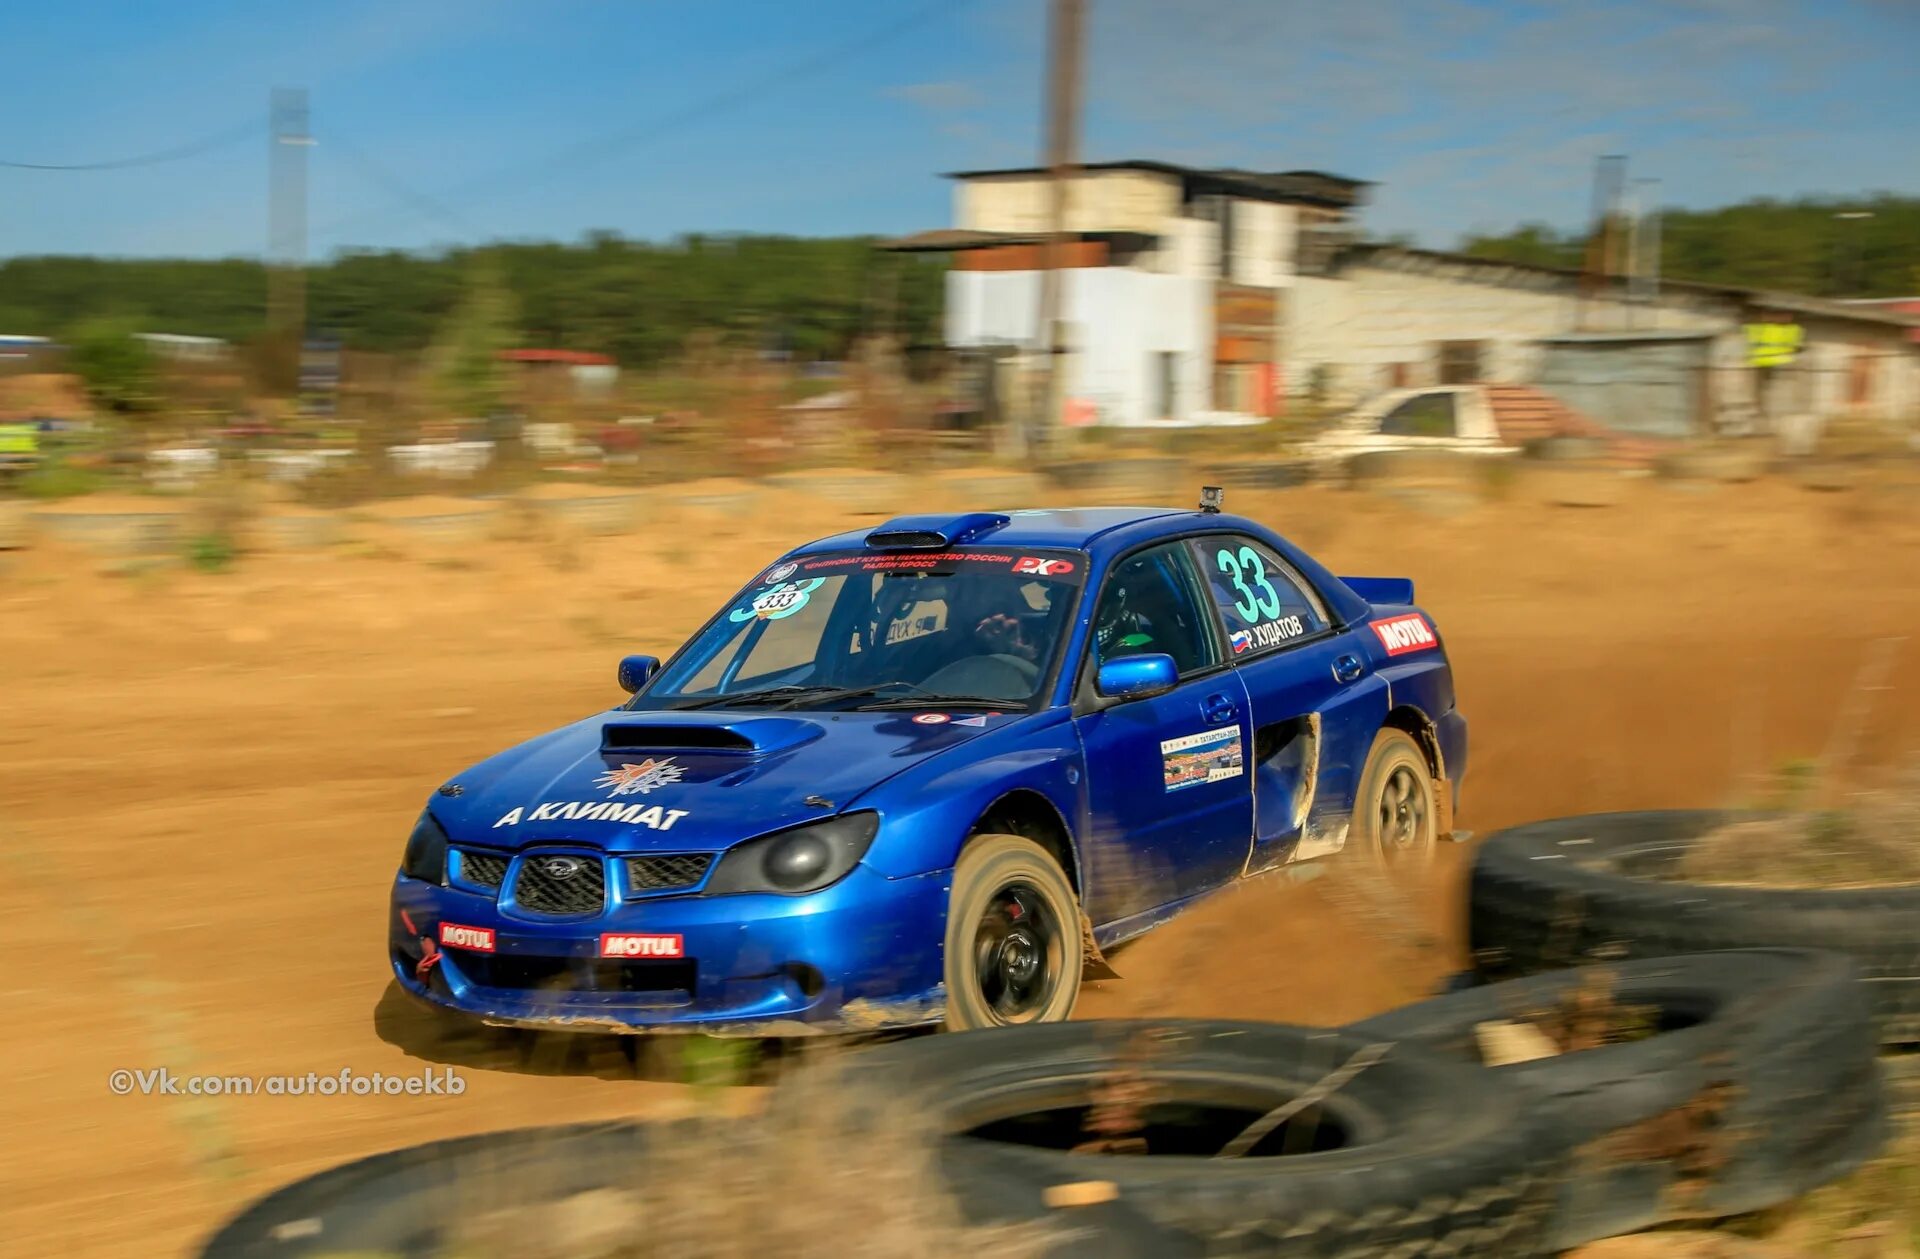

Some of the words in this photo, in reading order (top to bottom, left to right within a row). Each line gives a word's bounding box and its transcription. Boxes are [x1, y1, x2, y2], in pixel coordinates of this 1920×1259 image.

[862, 560, 938, 570] РАЛЛИ-КРОСС
[964, 553, 1013, 563] РОССИИ
[1217, 546, 1281, 624] 33
[758, 592, 798, 610] 333
[1377, 618, 1433, 651] MOTUL
[526, 801, 691, 831] КЛИМАТ
[442, 925, 493, 949] MOTUL
[604, 937, 681, 956] MOTUL
